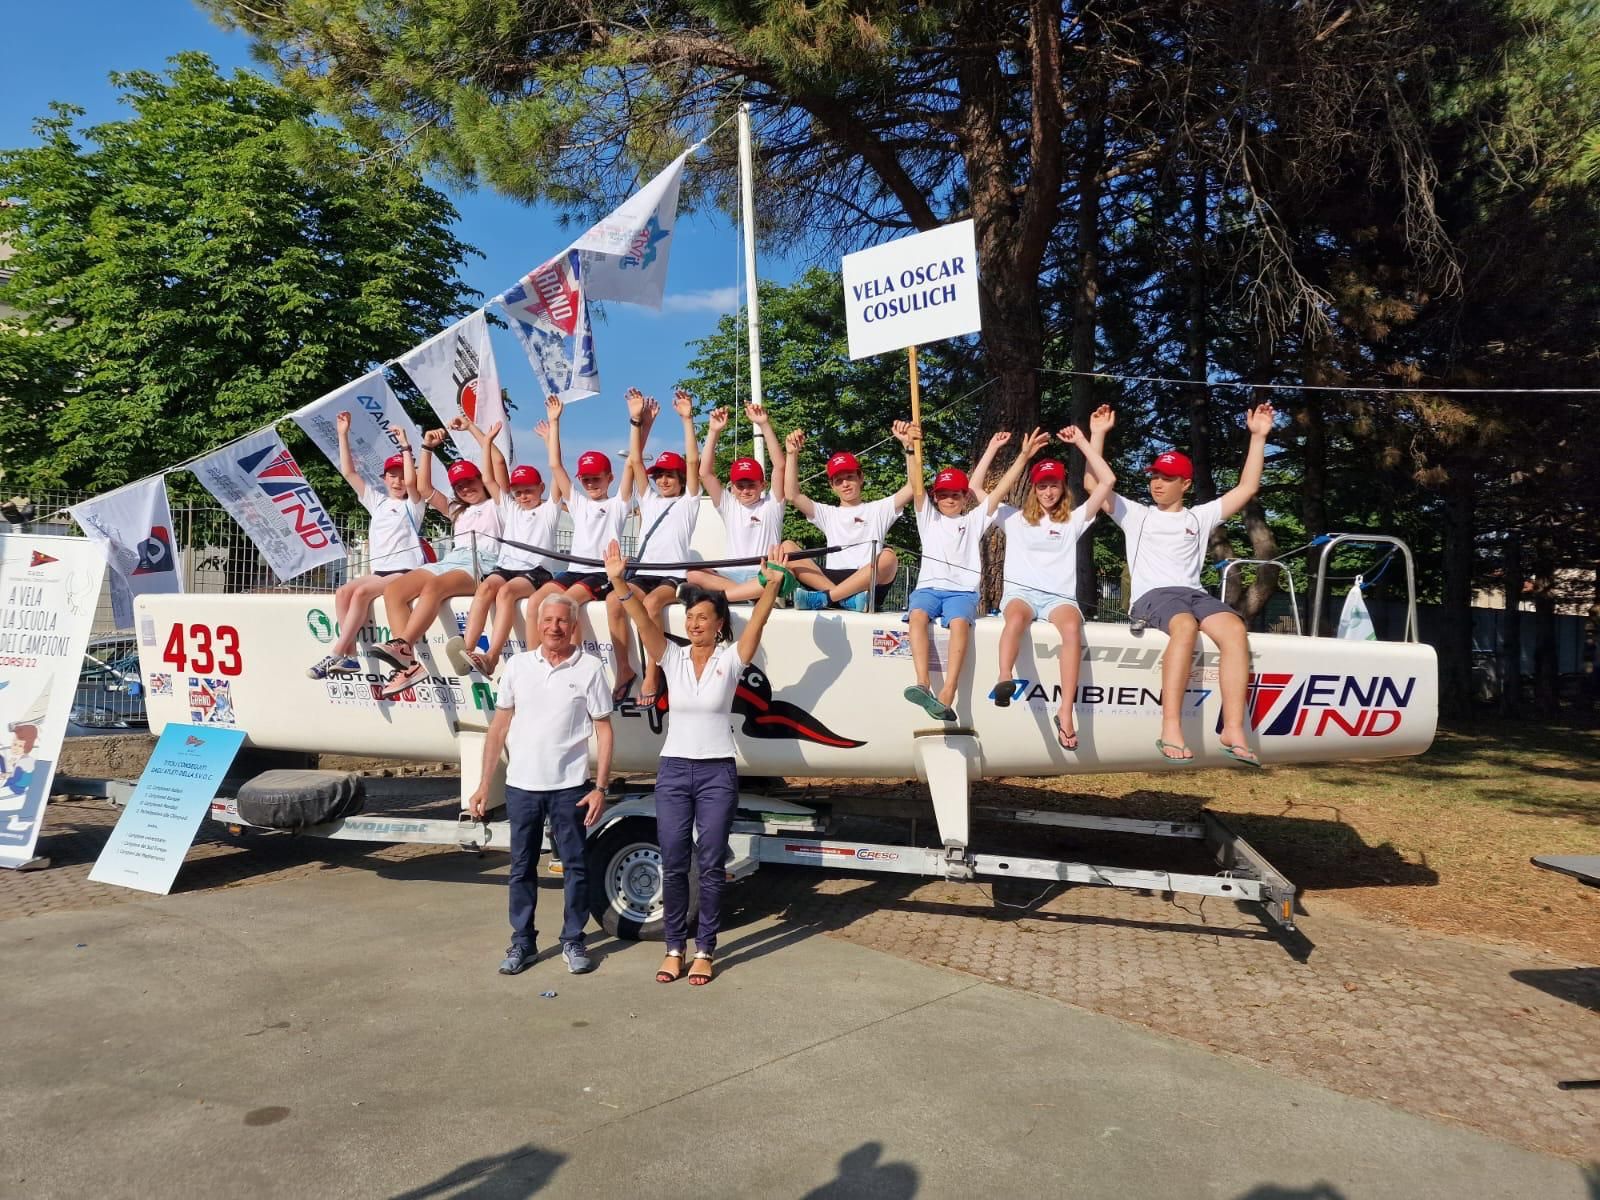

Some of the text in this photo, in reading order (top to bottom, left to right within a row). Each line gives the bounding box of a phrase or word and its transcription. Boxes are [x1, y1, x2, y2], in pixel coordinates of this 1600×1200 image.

[853, 257, 965, 301] VELA OSCAR
[863, 284, 956, 323] COSULICH
[20, 586, 42, 607] VELA
[16, 610, 57, 631] SCUOLA
[19, 634, 70, 657] CAMPIONI
[163, 623, 242, 676] 433
